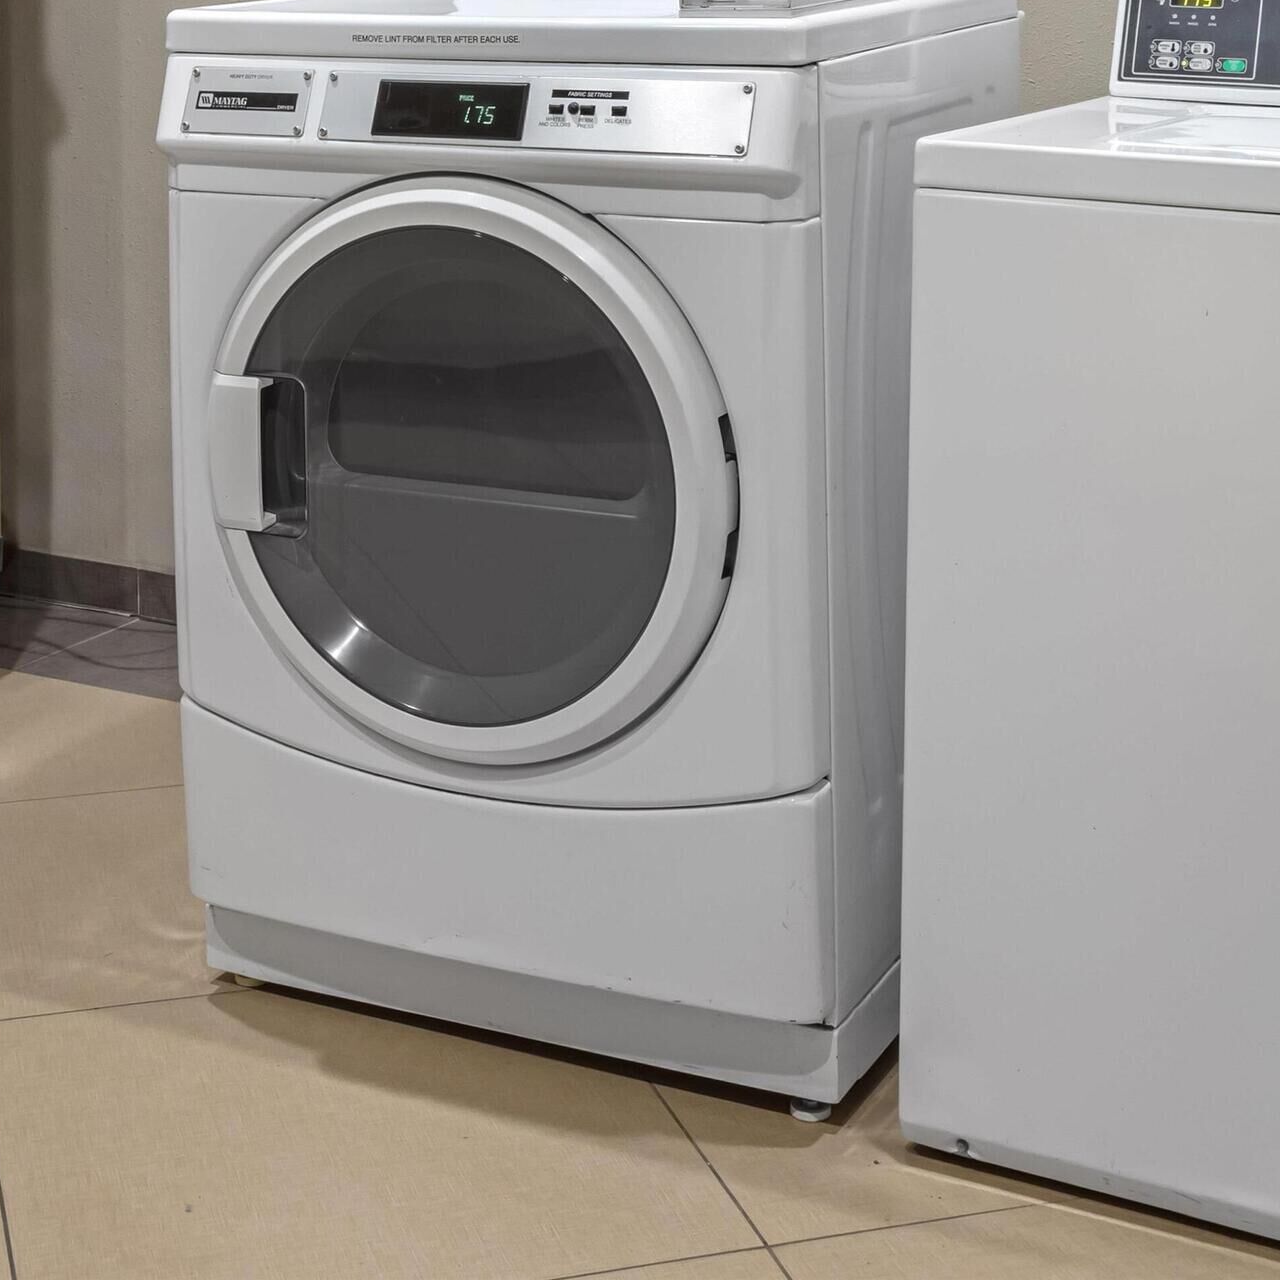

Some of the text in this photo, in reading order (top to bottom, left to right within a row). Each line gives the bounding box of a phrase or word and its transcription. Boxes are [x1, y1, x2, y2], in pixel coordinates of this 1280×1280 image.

[402, 35, 425, 43] FROM
[426, 35, 452, 43] FILTER
[453, 35, 478, 43] AFTER
[479, 35, 501, 43] EACH
[502, 35, 520, 43] USE.
[213, 97, 248, 106] MAYTAG
